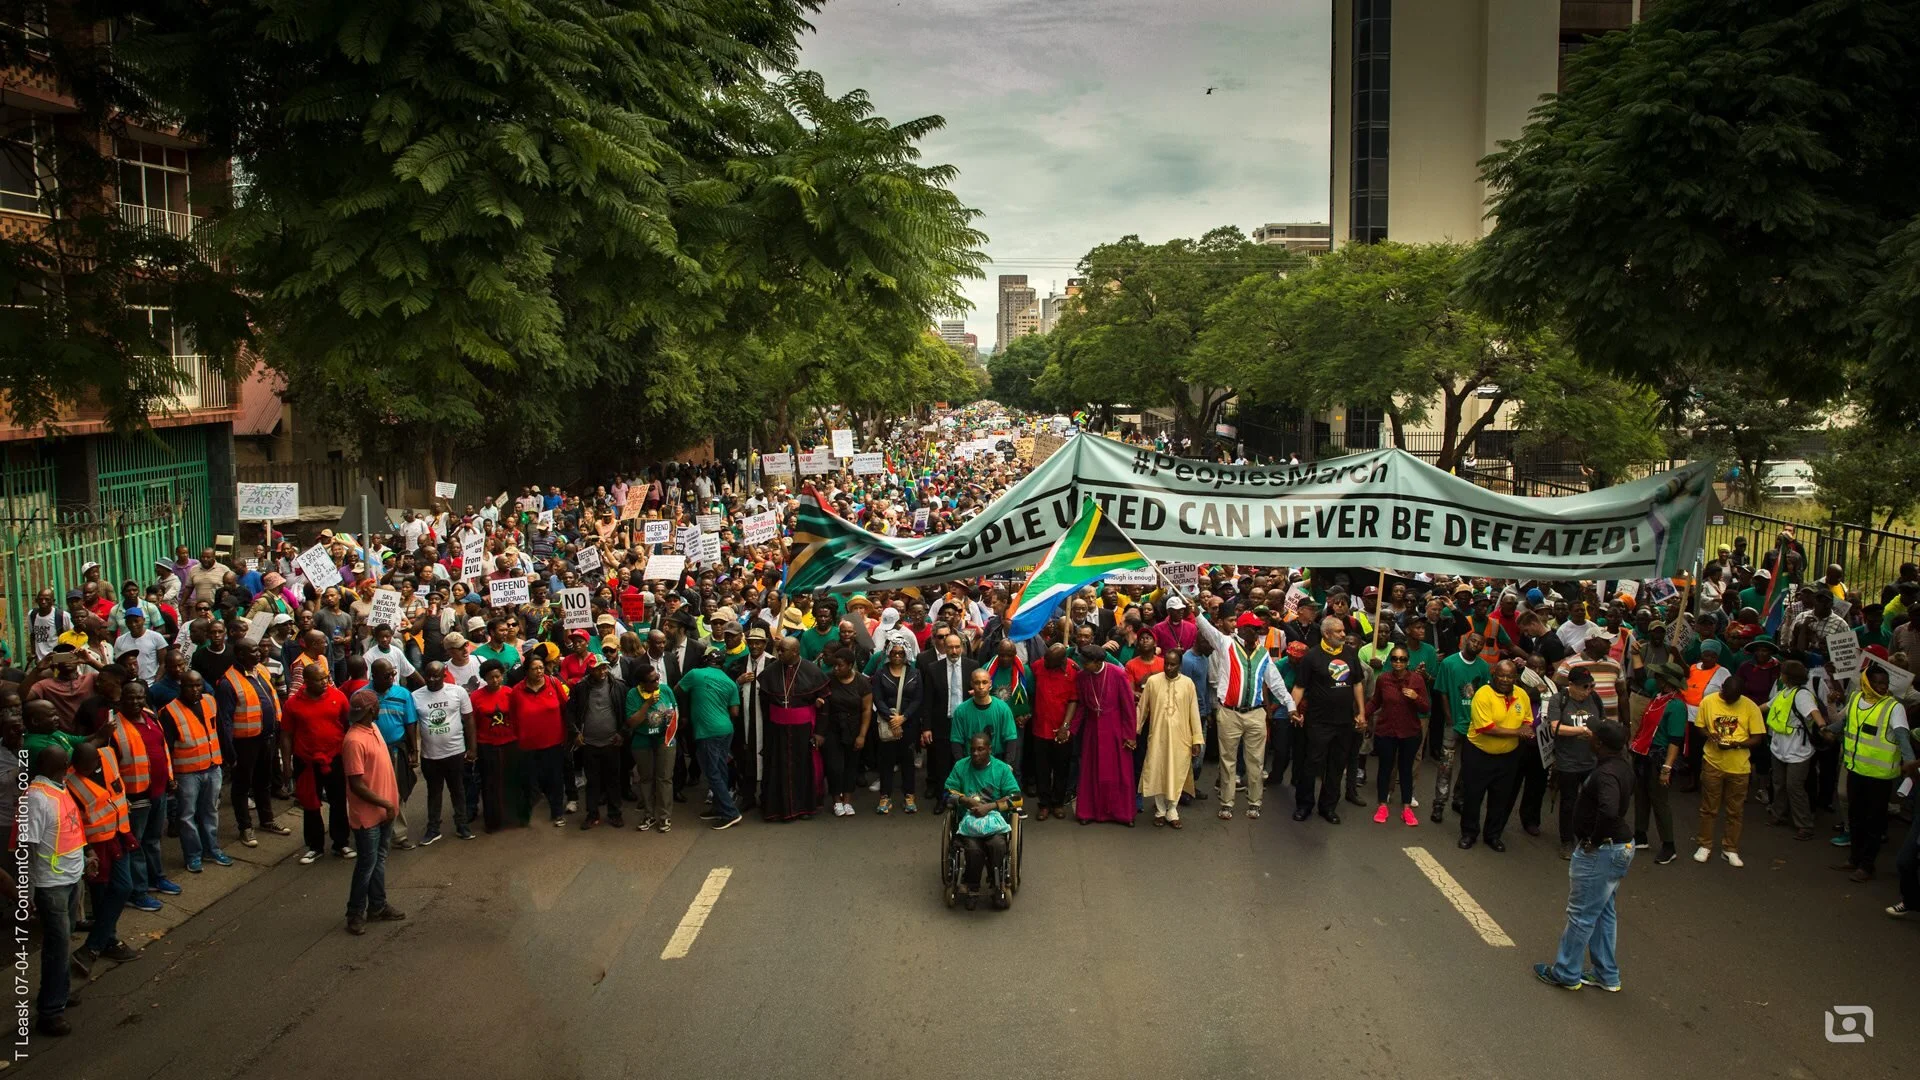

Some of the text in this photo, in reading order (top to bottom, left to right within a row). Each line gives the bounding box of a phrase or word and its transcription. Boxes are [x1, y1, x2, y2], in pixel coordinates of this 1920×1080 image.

[1132, 450, 1388, 489] #PeoplesMarch
[1053, 486, 1167, 531] UTED
[1179, 501, 1250, 538] CAN
[1264, 504, 1380, 539] NEVER
[1391, 505, 1434, 543] BE
[1443, 513, 1641, 557] DEFEATED!
[646, 523, 668, 532] DEFEND
[756, 526, 775, 536] Country
[466, 538, 484, 550] DELIVER
[301, 547, 322, 563] SOUTH
[465, 556, 481, 564] from
[312, 563, 326, 576] NOT
[465, 564, 480, 575] EVIL
[1162, 564, 1196, 575] DEFEND
[1134, 574, 1155, 582] enough
[492, 580, 526, 591] DEFEND
[493, 595, 527, 604] DEMOCRACY
[564, 593, 586, 610] NO
[373, 605, 396, 613] BELONGS
[428, 701, 449, 709] VOTE
